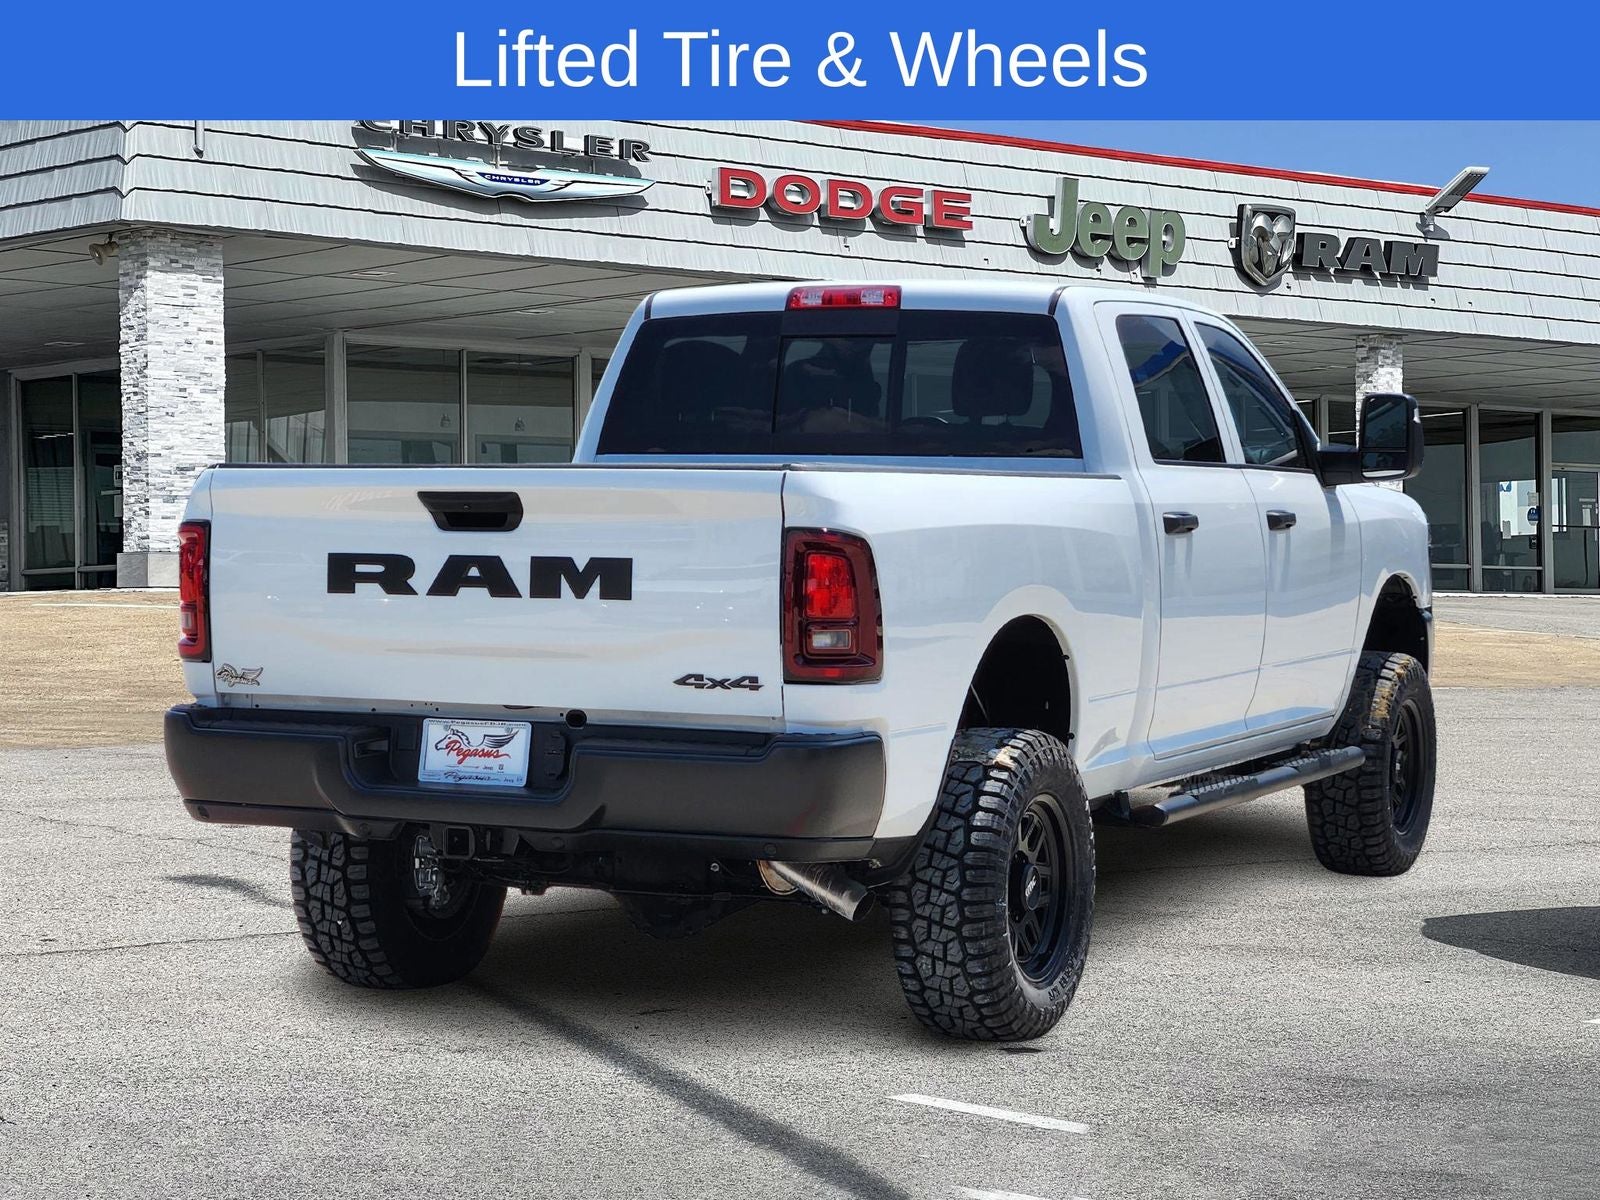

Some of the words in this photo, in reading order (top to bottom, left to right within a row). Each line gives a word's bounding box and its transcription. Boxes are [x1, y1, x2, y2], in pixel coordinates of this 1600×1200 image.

[485, 174, 541, 185] CHRYSLER
[711, 166, 974, 231] DODGE
[1026, 176, 1186, 278] Jeep
[1295, 232, 1440, 277] RAM
[327, 552, 633, 600] RAM
[672, 673, 765, 691] 4x4
[445, 739, 512, 765] Pegasus
